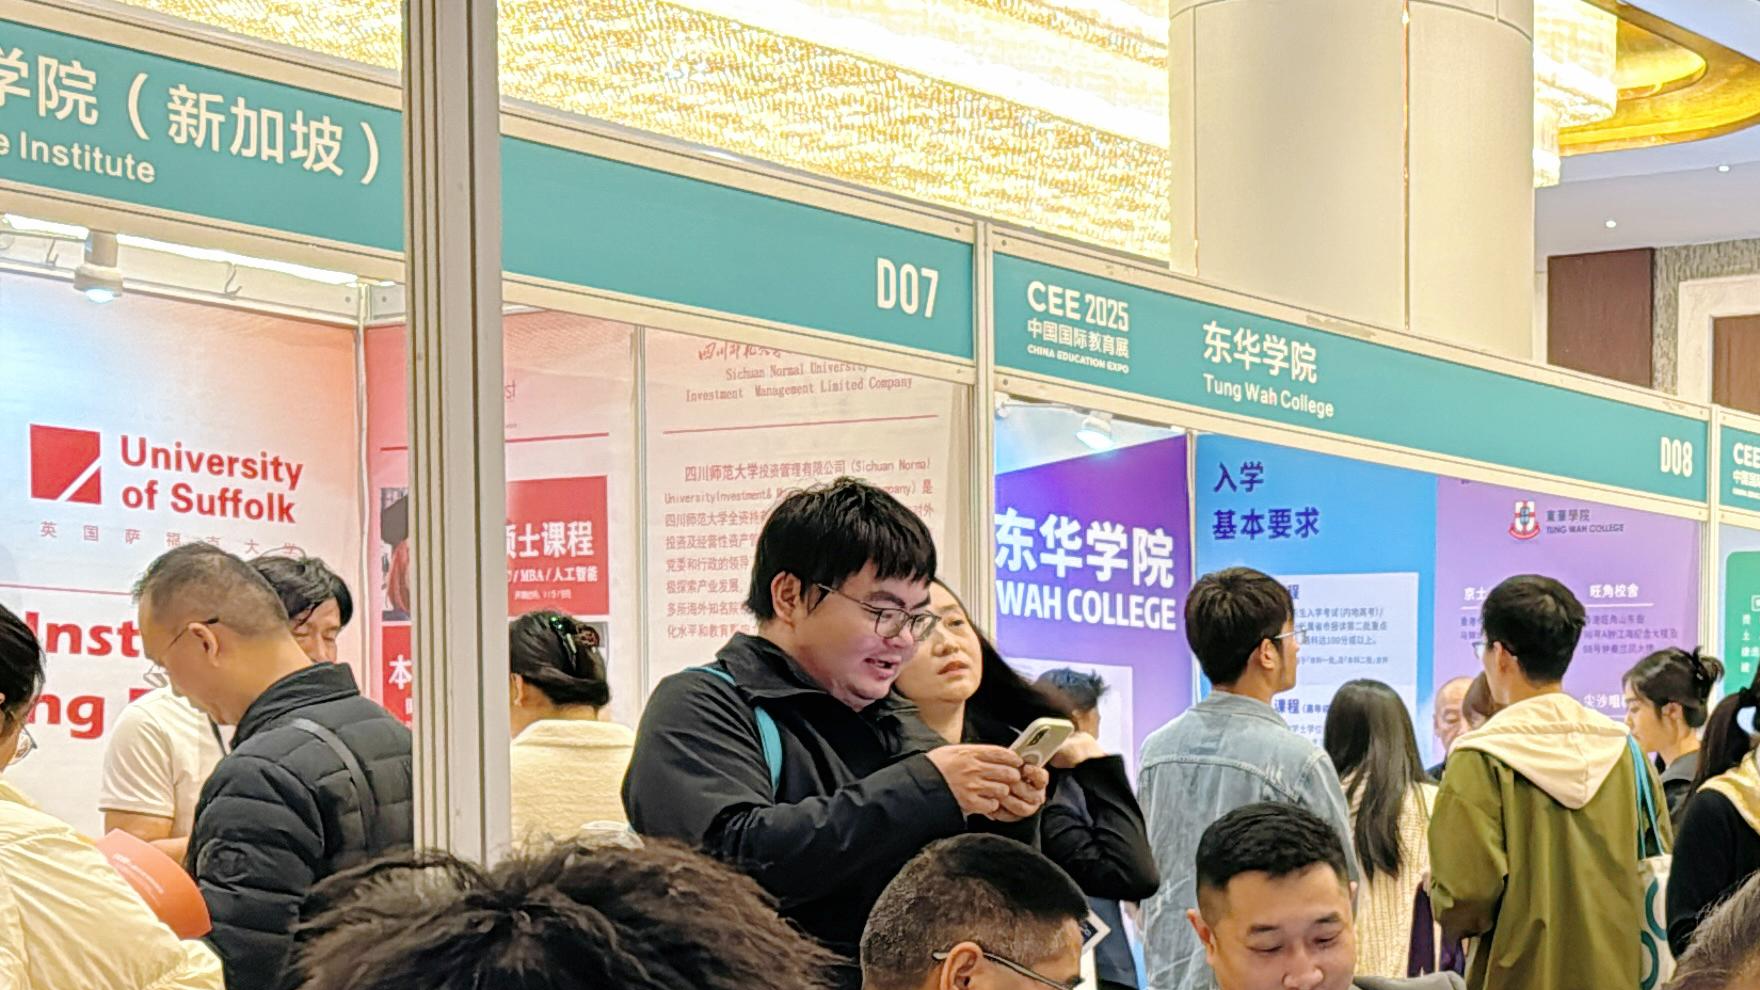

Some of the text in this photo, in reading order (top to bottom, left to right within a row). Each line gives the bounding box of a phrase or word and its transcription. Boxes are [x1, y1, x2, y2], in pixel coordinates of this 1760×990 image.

[20, 130, 155, 184] Institute
[876, 257, 939, 319] D07
[1027, 281, 1129, 332] CEE 2025
[1027, 318, 1129, 359] 中国国际教育展
[1027, 344, 1130, 375] CHINA EDUCATION EXPO
[1202, 320, 1318, 385] 东华学院
[686, 375, 913, 402] Investment Management Limited Company
[725, 367, 764, 381] Sichuan
[770, 363, 804, 378] Normal
[1202, 373, 1334, 419] Tung Wah College
[120, 435, 303, 490] University
[1213, 460, 1265, 494] 入学
[1660, 437, 1692, 477] D08
[1733, 442, 1760, 469] CEE
[122, 480, 297, 524] of Suffolk
[1213, 506, 1321, 541] 基本要求
[995, 507, 1174, 589] 东华学院
[996, 580, 1177, 631] WAH COLLEGE
